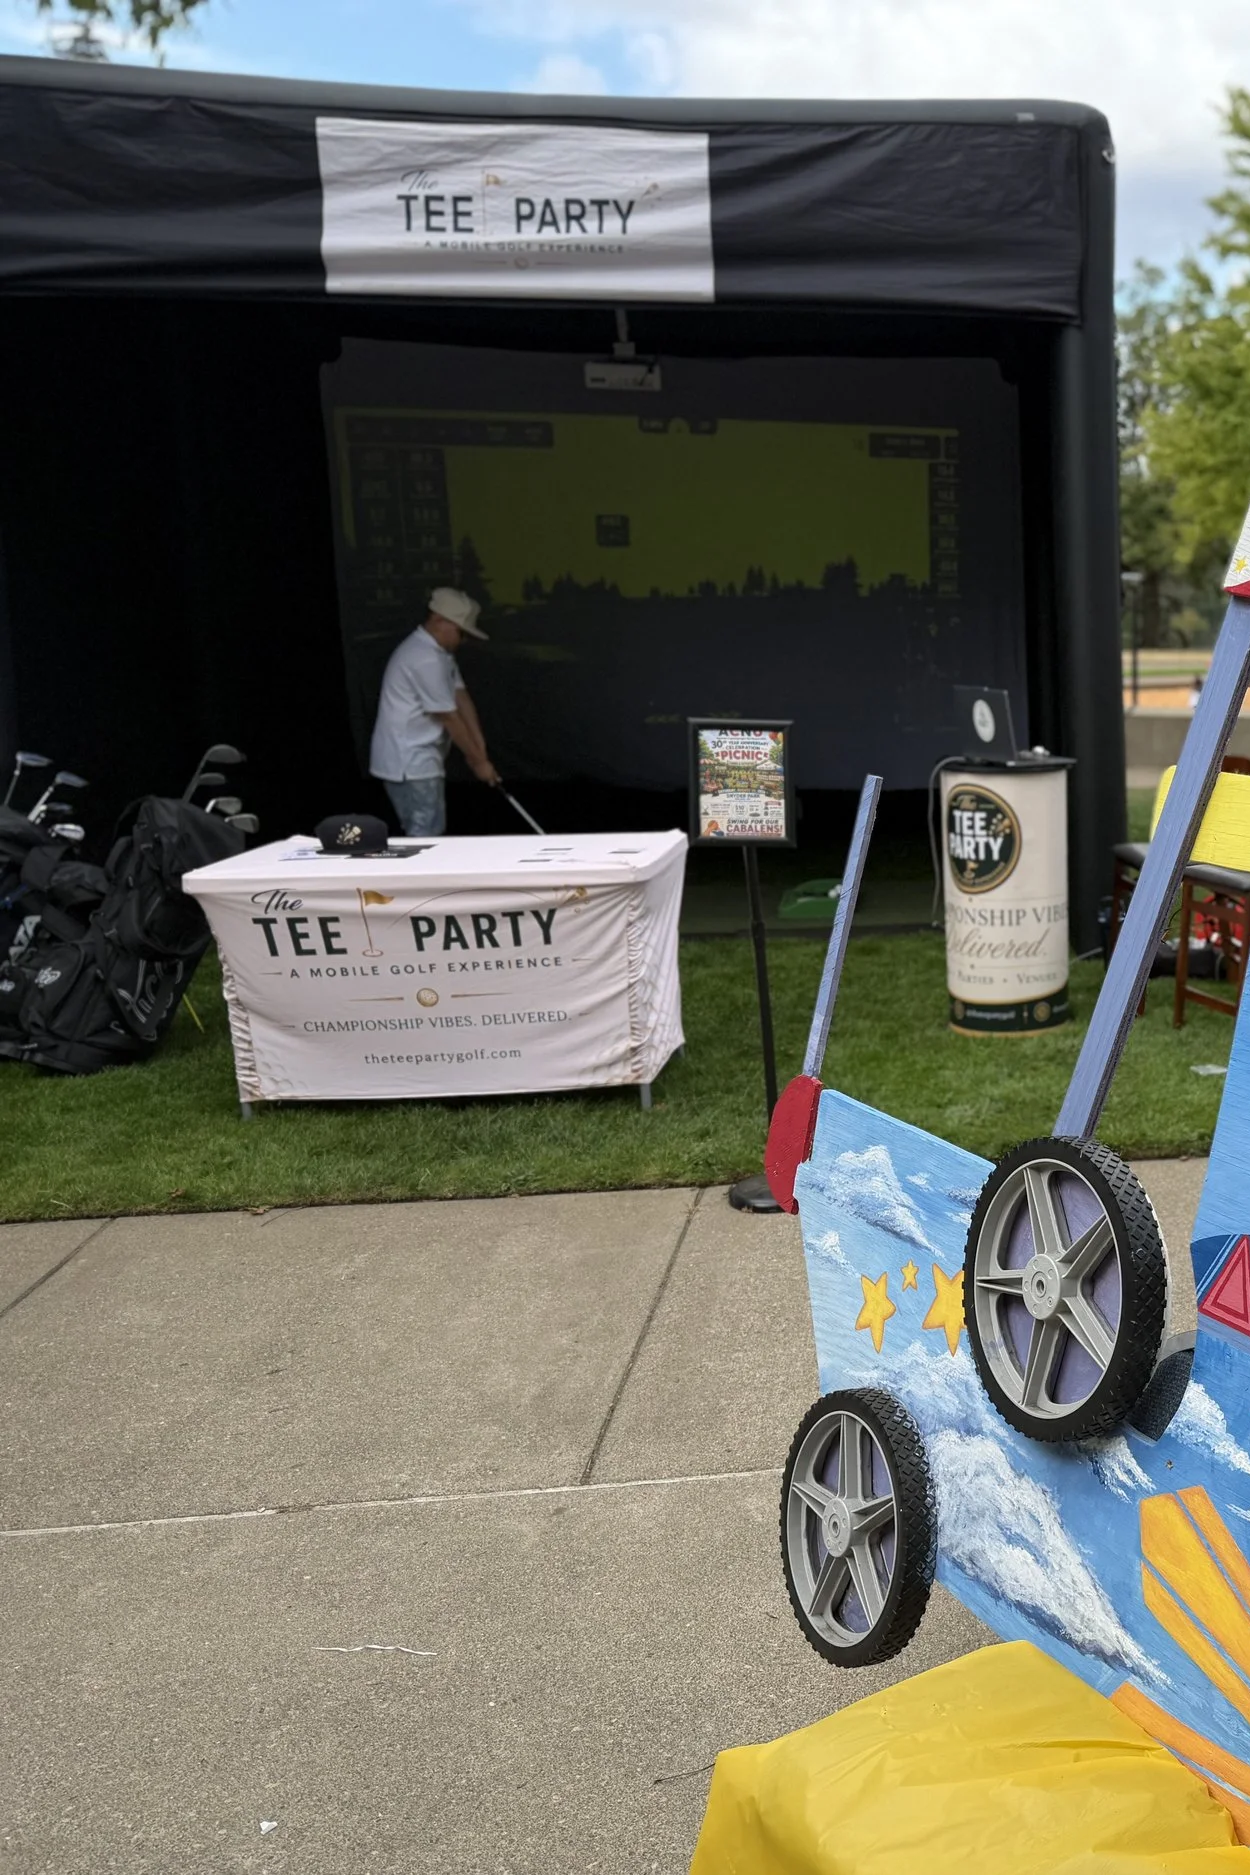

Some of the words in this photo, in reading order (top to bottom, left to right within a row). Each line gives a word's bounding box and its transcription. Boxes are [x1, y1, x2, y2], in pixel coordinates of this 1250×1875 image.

[400, 169, 439, 192] The
[397, 195, 475, 233] TEE
[515, 197, 635, 235] PARTY
[424, 240, 432, 248] A
[440, 241, 491, 251] MOBILE
[498, 242, 532, 252] GOLF
[539, 243, 625, 254] EXPERIENCE
[720, 750, 764, 760] PICNIC
[953, 809, 988, 835] TEE
[949, 832, 1004, 861] PARTY
[251, 888, 303, 914] The
[252, 915, 348, 957] TEE
[410, 908, 558, 953] PARTY
[290, 968, 301, 979] A
[309, 964, 381, 979] MOBILE
[390, 963, 438, 976] GOLF
[447, 956, 563, 973] EXPERIENCE
[303, 1016, 425, 1034] CHAMPIONSHIP
[427, 1014, 477, 1030] VIBES.
[481, 1009, 572, 1027] DELIVERED.
[364, 1047, 522, 1066] theteepartygolf.com
